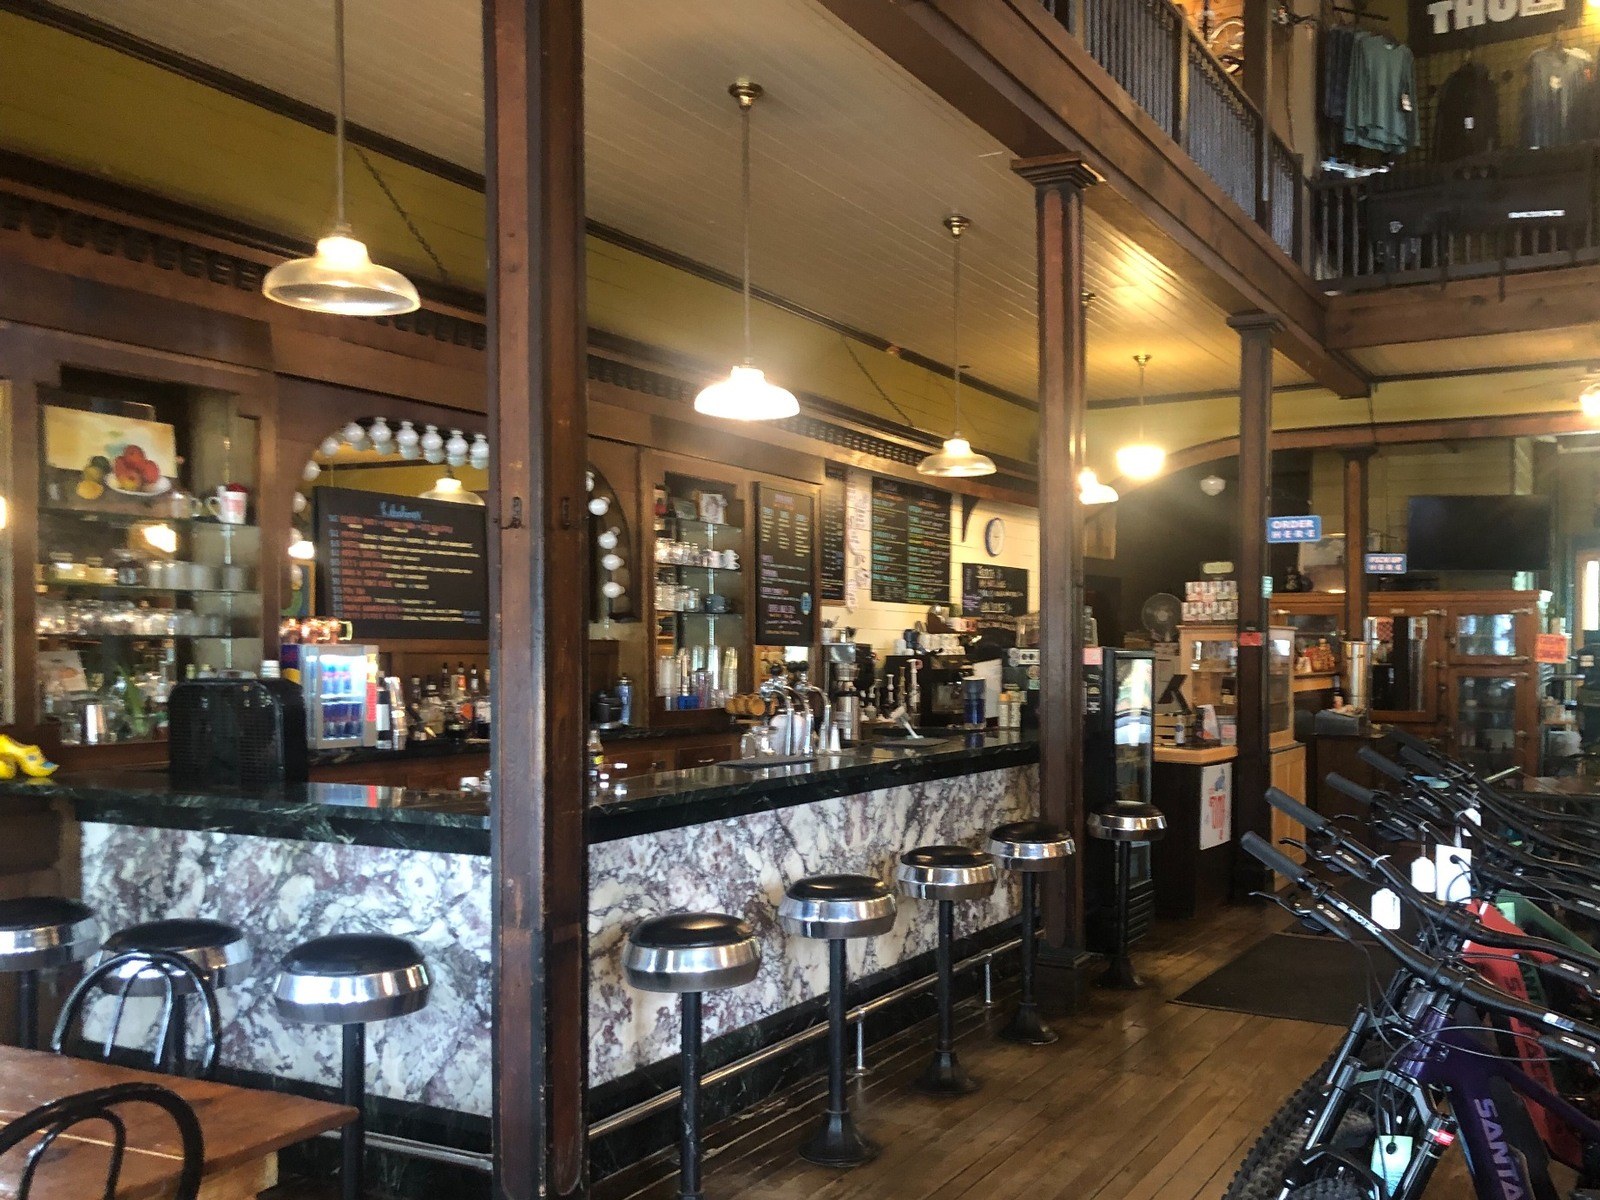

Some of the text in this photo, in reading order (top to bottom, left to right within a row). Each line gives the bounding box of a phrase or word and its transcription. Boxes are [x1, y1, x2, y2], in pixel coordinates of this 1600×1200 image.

[1271, 519, 1314, 529] ORDER
[1271, 529, 1315, 539] HERE
[1473, 1098, 1524, 1200] SANTA
